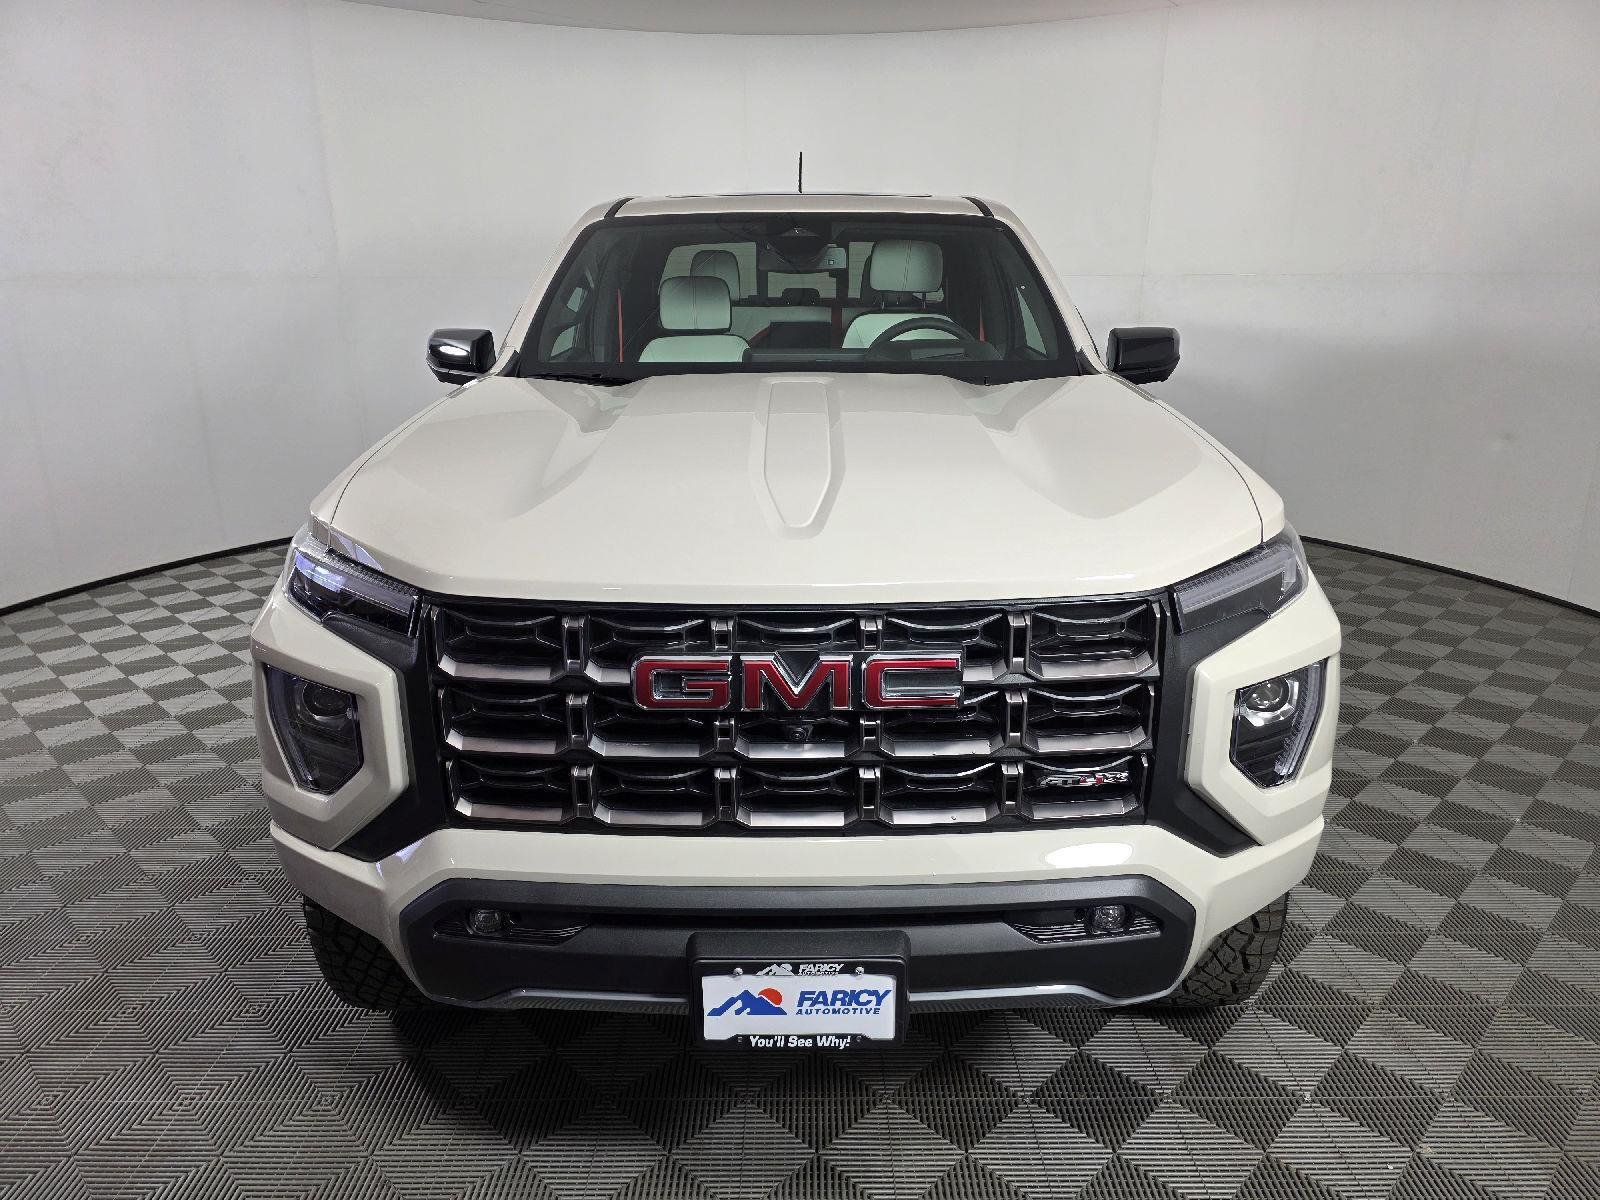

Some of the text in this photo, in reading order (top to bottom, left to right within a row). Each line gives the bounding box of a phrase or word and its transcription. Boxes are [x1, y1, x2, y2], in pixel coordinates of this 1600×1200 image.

[632, 650, 963, 711] GMC
[798, 963, 845, 972] FARICY
[796, 989, 892, 1007] FARICY
[795, 1007, 881, 1016] AUTOMOTIVE
[749, 1035, 851, 1050] You'll See Why!
